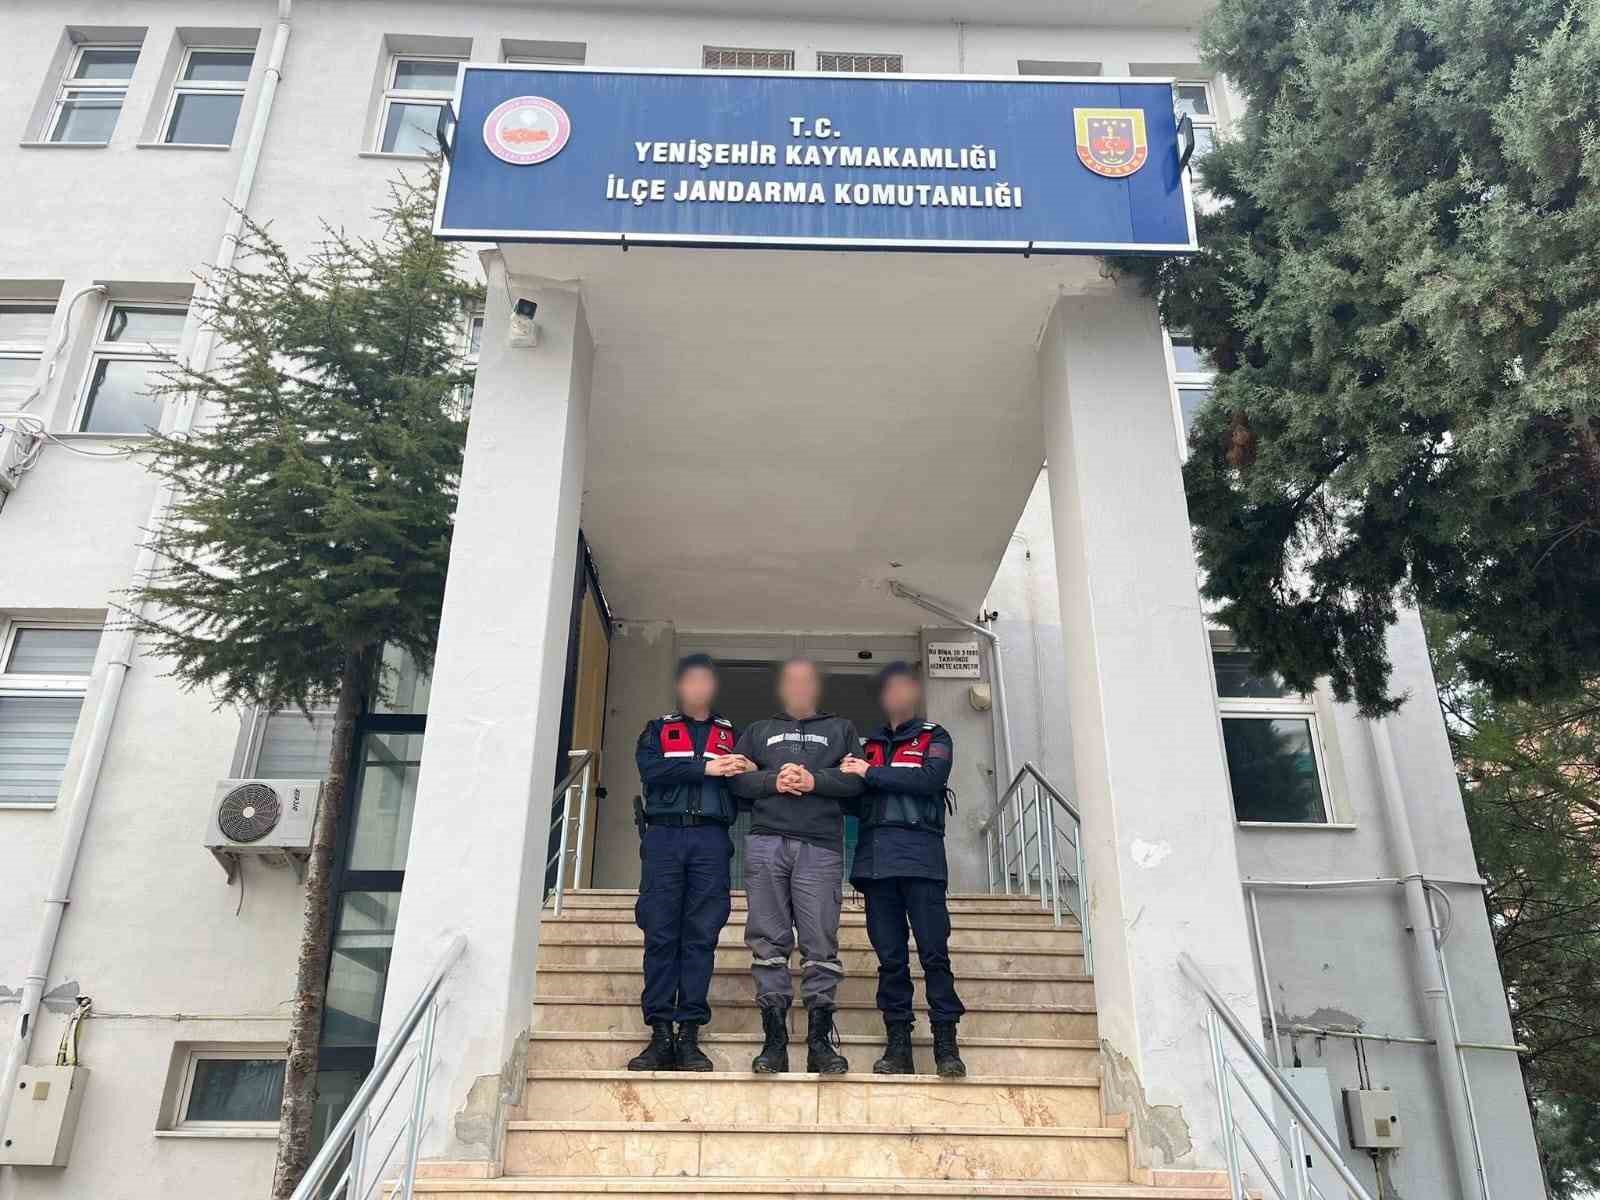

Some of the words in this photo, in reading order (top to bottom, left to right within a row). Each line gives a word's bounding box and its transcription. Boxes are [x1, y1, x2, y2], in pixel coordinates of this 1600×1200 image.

[789, 116, 842, 138] T.C.
[634, 138, 778, 170] YENİŞEHİR
[784, 143, 997, 170] KAYMAKAMLIĞI
[605, 173, 666, 206] İLÇE
[673, 179, 826, 204] JANDARMA
[834, 181, 1023, 208] KOMUTANLIĞI
